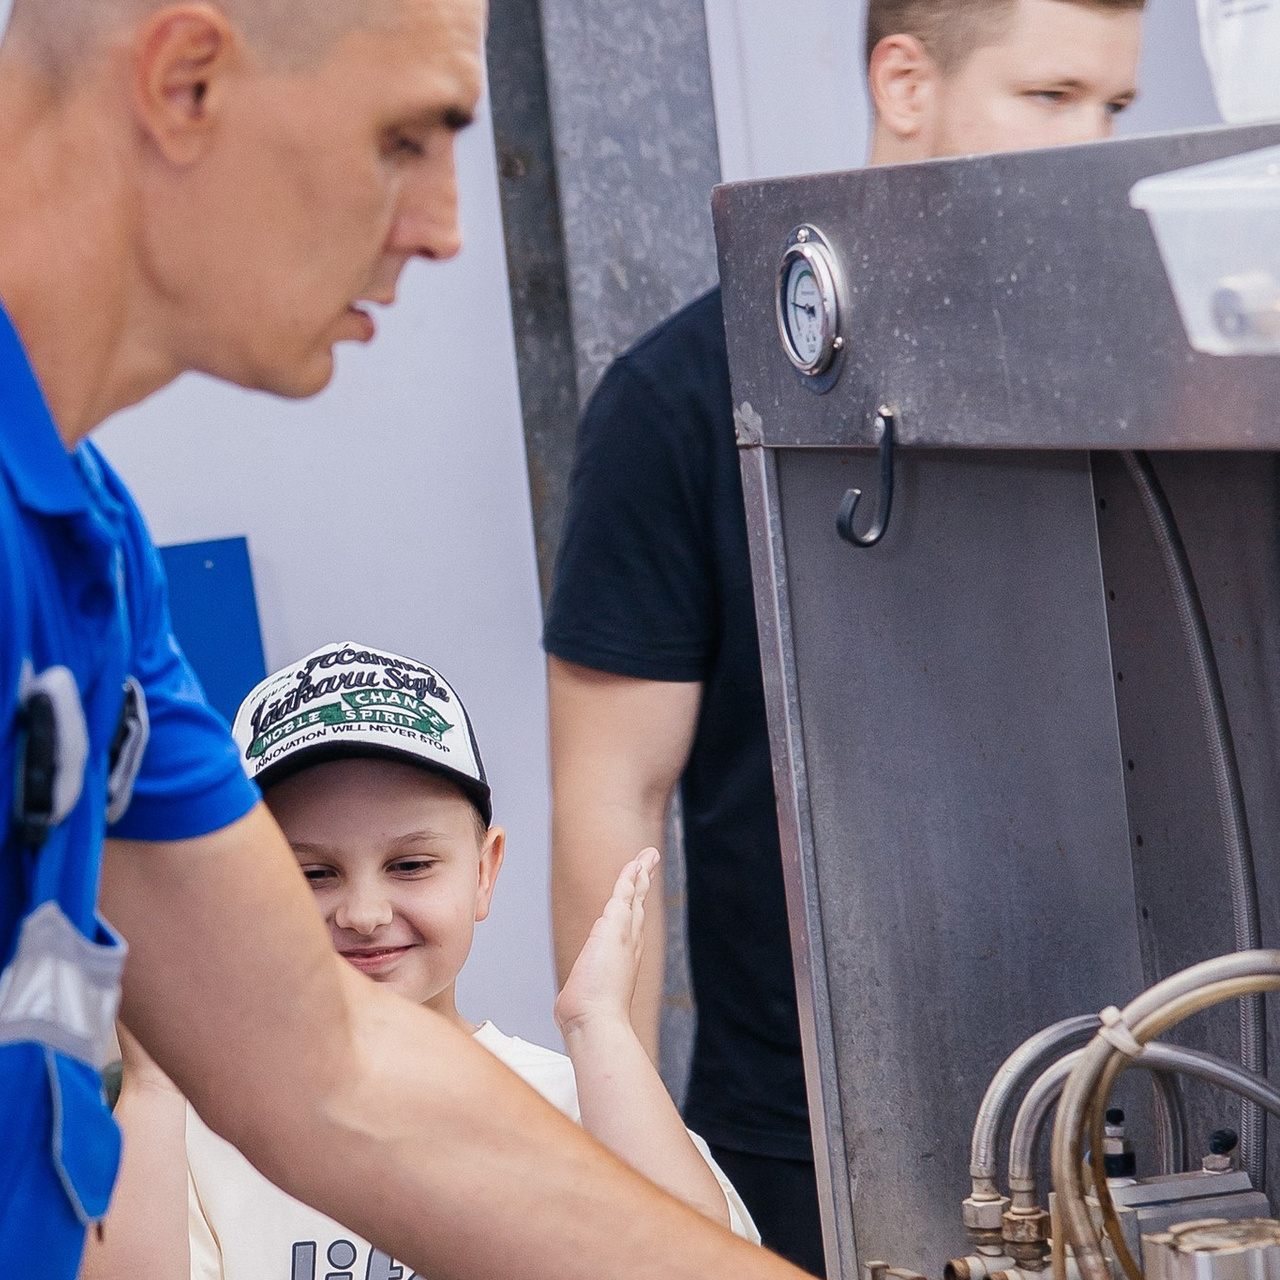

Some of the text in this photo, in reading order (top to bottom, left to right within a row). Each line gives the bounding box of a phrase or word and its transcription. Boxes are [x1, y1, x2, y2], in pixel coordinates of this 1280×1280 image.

[383, 668, 451, 702] Style
[255, 724, 451, 772] INNOVATION WILL NEVER STOP
[261, 710, 417, 748] NOBLE SPIRIT
